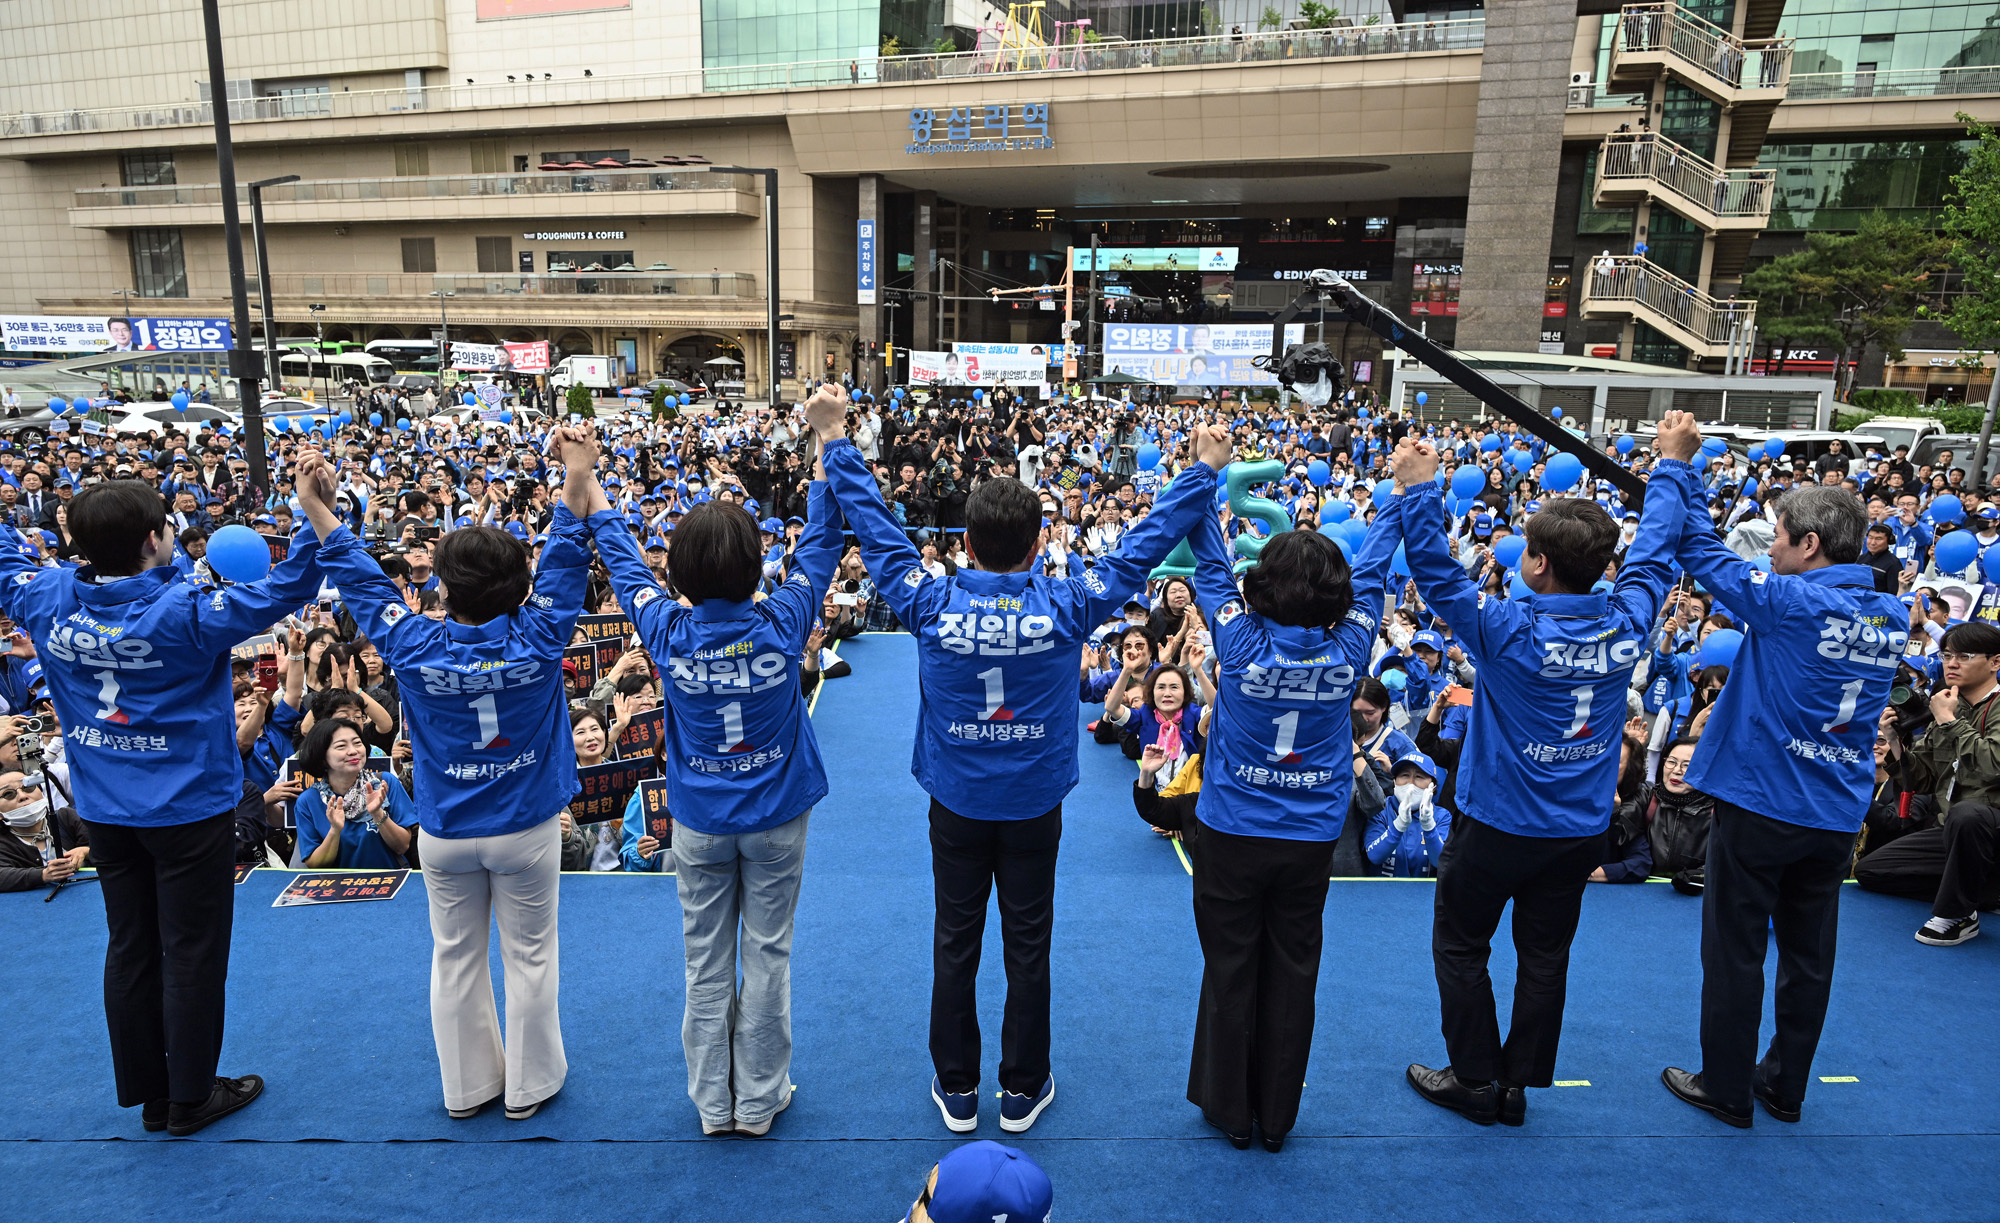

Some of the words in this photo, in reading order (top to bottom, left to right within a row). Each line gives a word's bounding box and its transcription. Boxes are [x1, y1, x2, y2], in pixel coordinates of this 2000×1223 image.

[908, 103, 1049, 143] 왕십리역
[904, 142, 965, 155] Wangsimni
[967, 141, 1006, 152] Station
[537, 232, 586, 240] DOUGHNUTS
[596, 231, 624, 239] COFFEE
[1177, 235, 1199, 243] JUNO
[1201, 234, 1222, 242] HAIR
[862, 241, 871, 272] 주차장
[5, 322, 29, 332] 30분
[31, 322, 52, 333] 통근,
[54, 322, 85, 333] 36만호
[86, 322, 104, 333] 공급
[9, 335, 47, 346] AI글로벌
[49, 335, 67, 346] 수도
[135, 319, 156, 350] 1
[154, 327, 224, 349] 정원오
[1540, 331, 1561, 341] 벤션
[452, 351, 496, 365] 구의원후보
[957, 344, 986, 354] 계속되는
[988, 344, 1019, 355] 성동시대
[1787, 350, 1818, 360] KFC
[1062, 468, 1080, 482] 정원오
[47, 616, 164, 670] 정원오
[602, 622, 620, 637] 일자리
[937, 613, 1055, 656] 정원오
[1817, 616, 1909, 669] 정원오
[28, 665, 42, 676] 정원
[420, 661, 544, 695] 정원오
[669, 652, 787, 695] 정원오
[1240, 664, 1354, 701] 정원오
[94, 670, 129, 725] 1
[977, 667, 1013, 720] 1
[1821, 678, 1865, 733] 1
[469, 693, 510, 750] 1
[1562, 684, 1596, 739] 1
[67, 724, 169, 752] 서울시장후보
[716, 701, 753, 752] 1
[948, 721, 1046, 742] 서울시장후보
[1266, 710, 1302, 764] 1
[690, 745, 784, 772] 서울시장후보
[1236, 764, 1333, 789] 서울시장후보
[571, 797, 613, 818] 행복한
